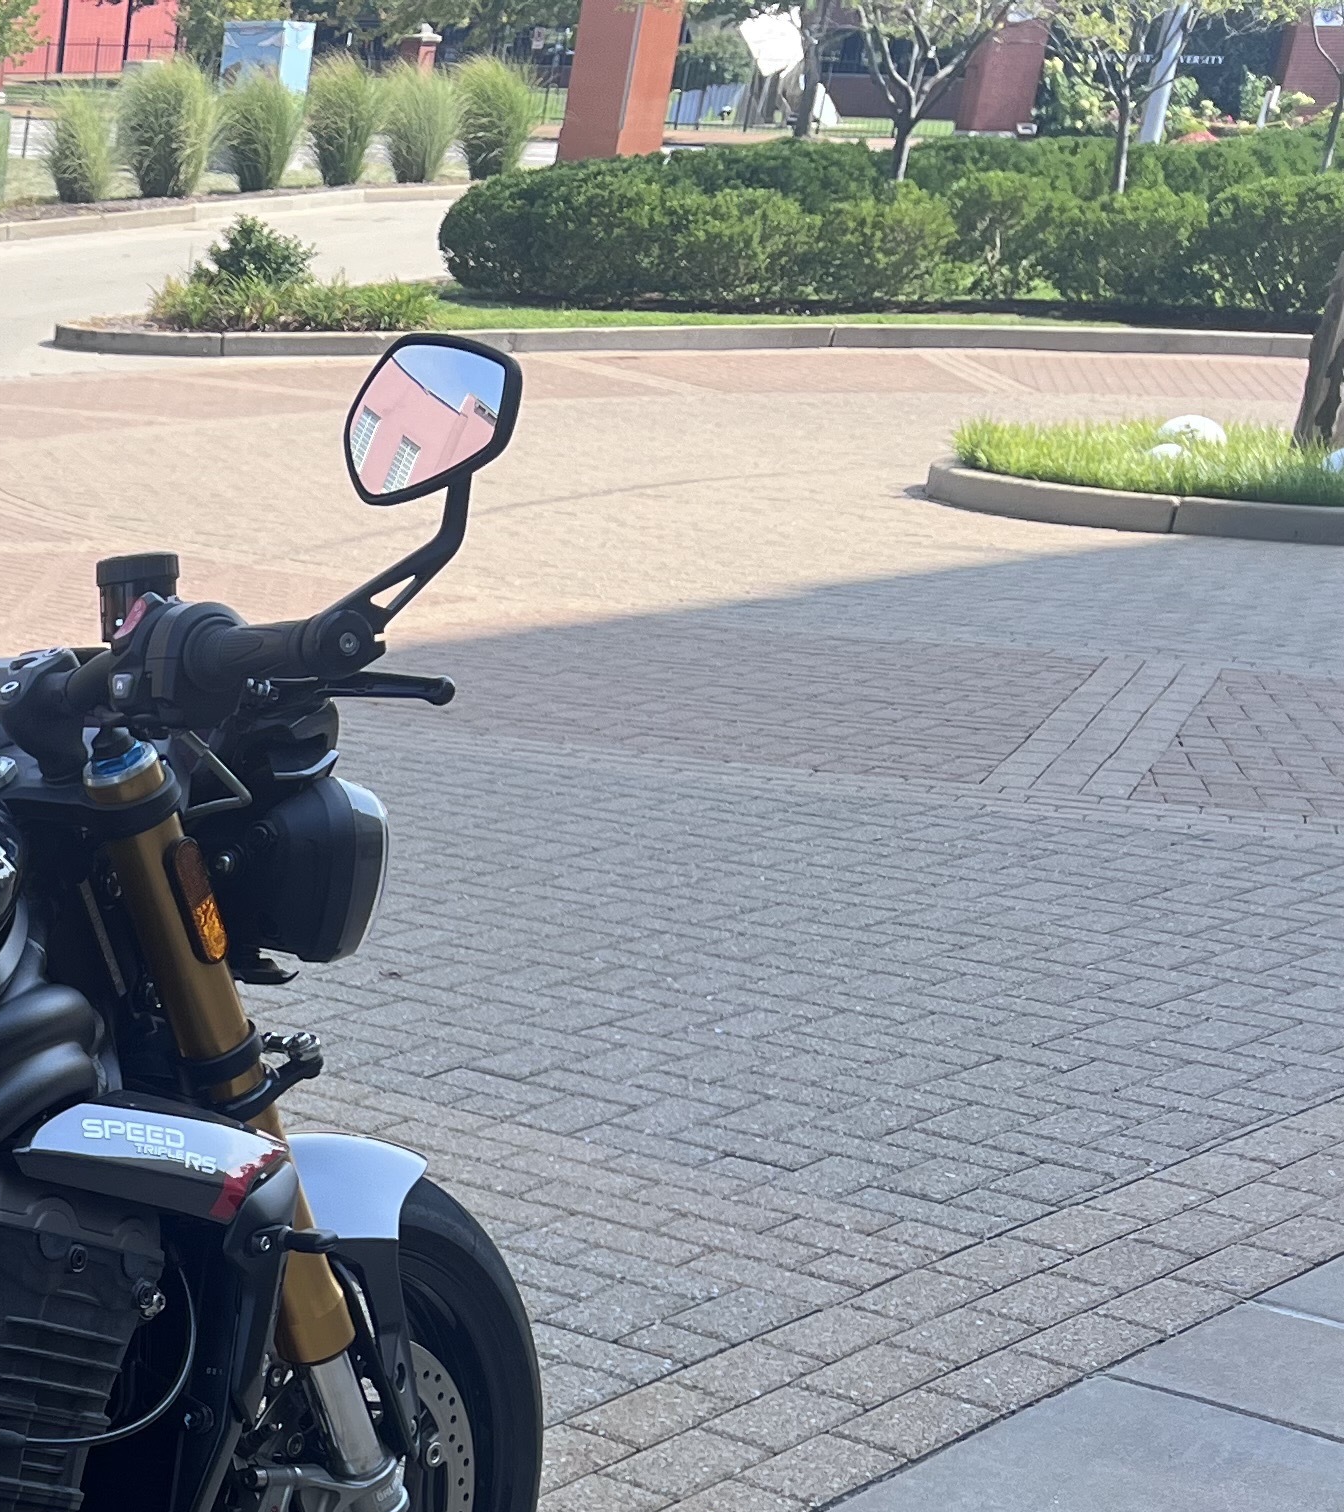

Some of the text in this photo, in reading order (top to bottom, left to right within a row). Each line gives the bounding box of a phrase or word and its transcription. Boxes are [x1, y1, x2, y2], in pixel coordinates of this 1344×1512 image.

[81, 1118, 185, 1149] SPEED
[134, 1142, 217, 1175] TRIPLE RS
